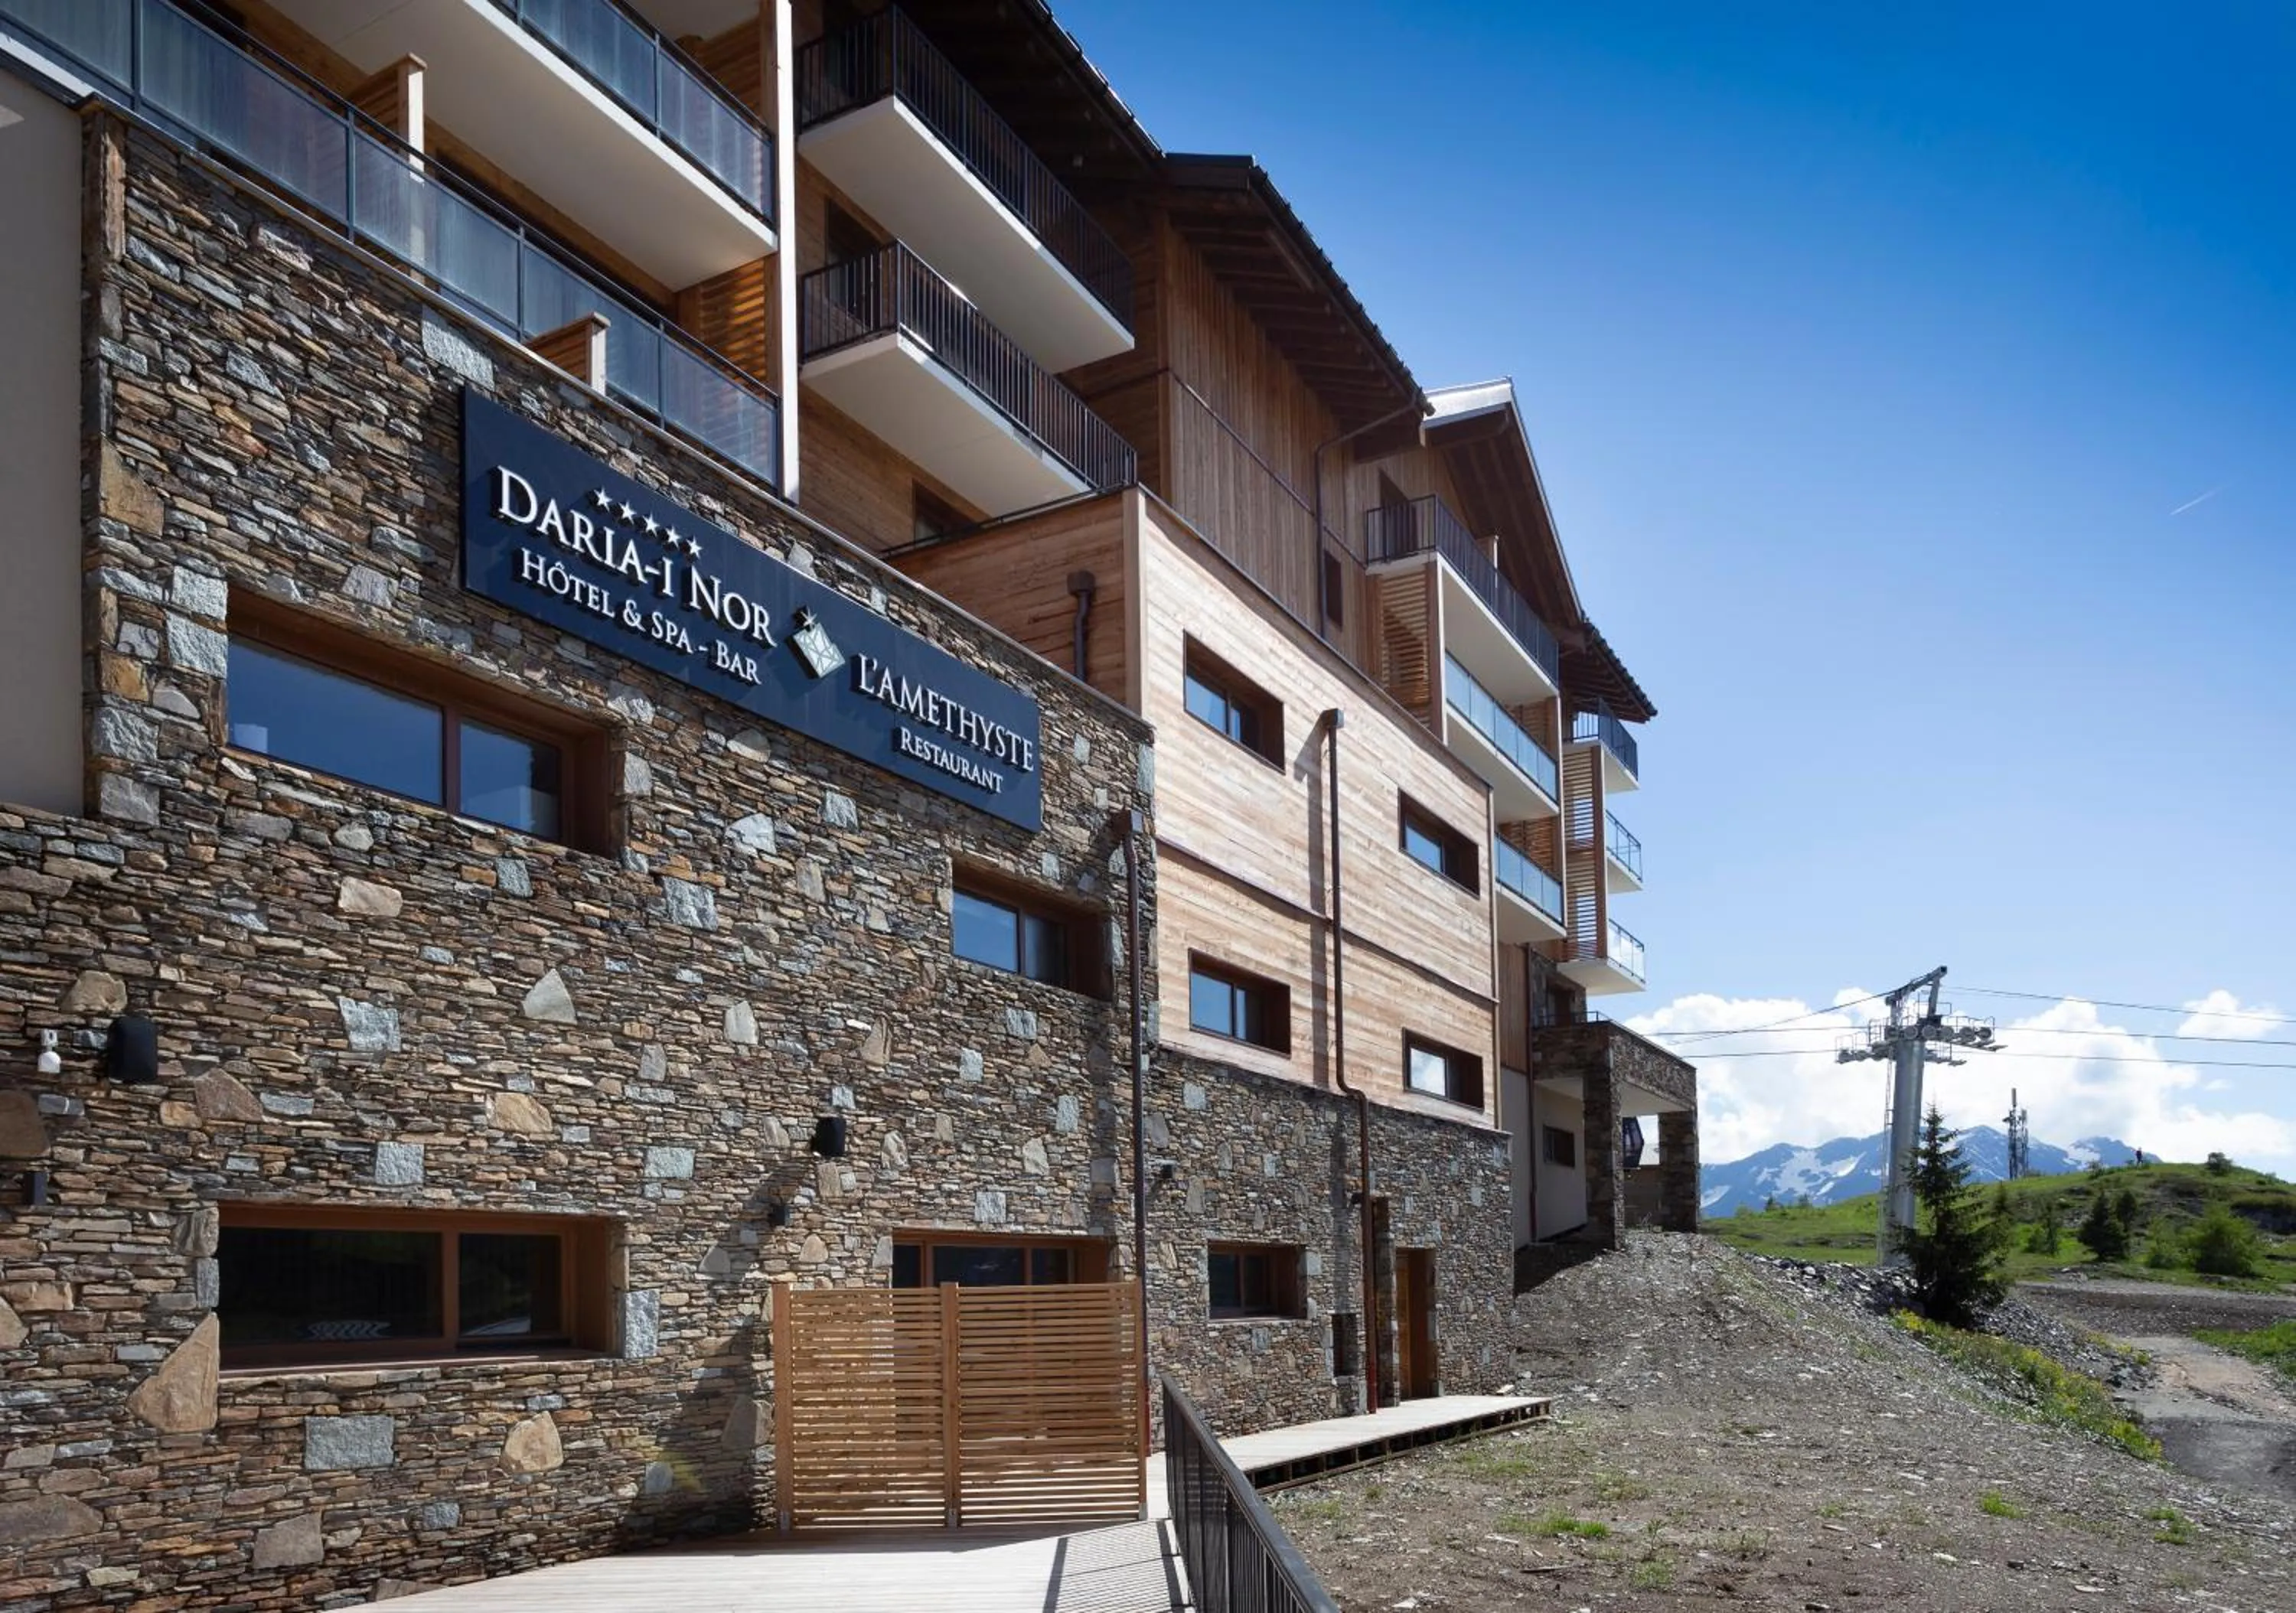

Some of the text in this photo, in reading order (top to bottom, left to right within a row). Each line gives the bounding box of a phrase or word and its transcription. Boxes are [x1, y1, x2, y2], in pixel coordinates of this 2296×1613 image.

[497, 465, 778, 648] DARIA-I NOR
[521, 547, 615, 618] HÔTEL
[623, 599, 646, 632] &
[651, 611, 693, 654] SPA
[716, 640, 762, 685] BAR
[857, 653, 1034, 771] L'AMETHYSTE
[900, 728, 1003, 793] RESTAURANT
